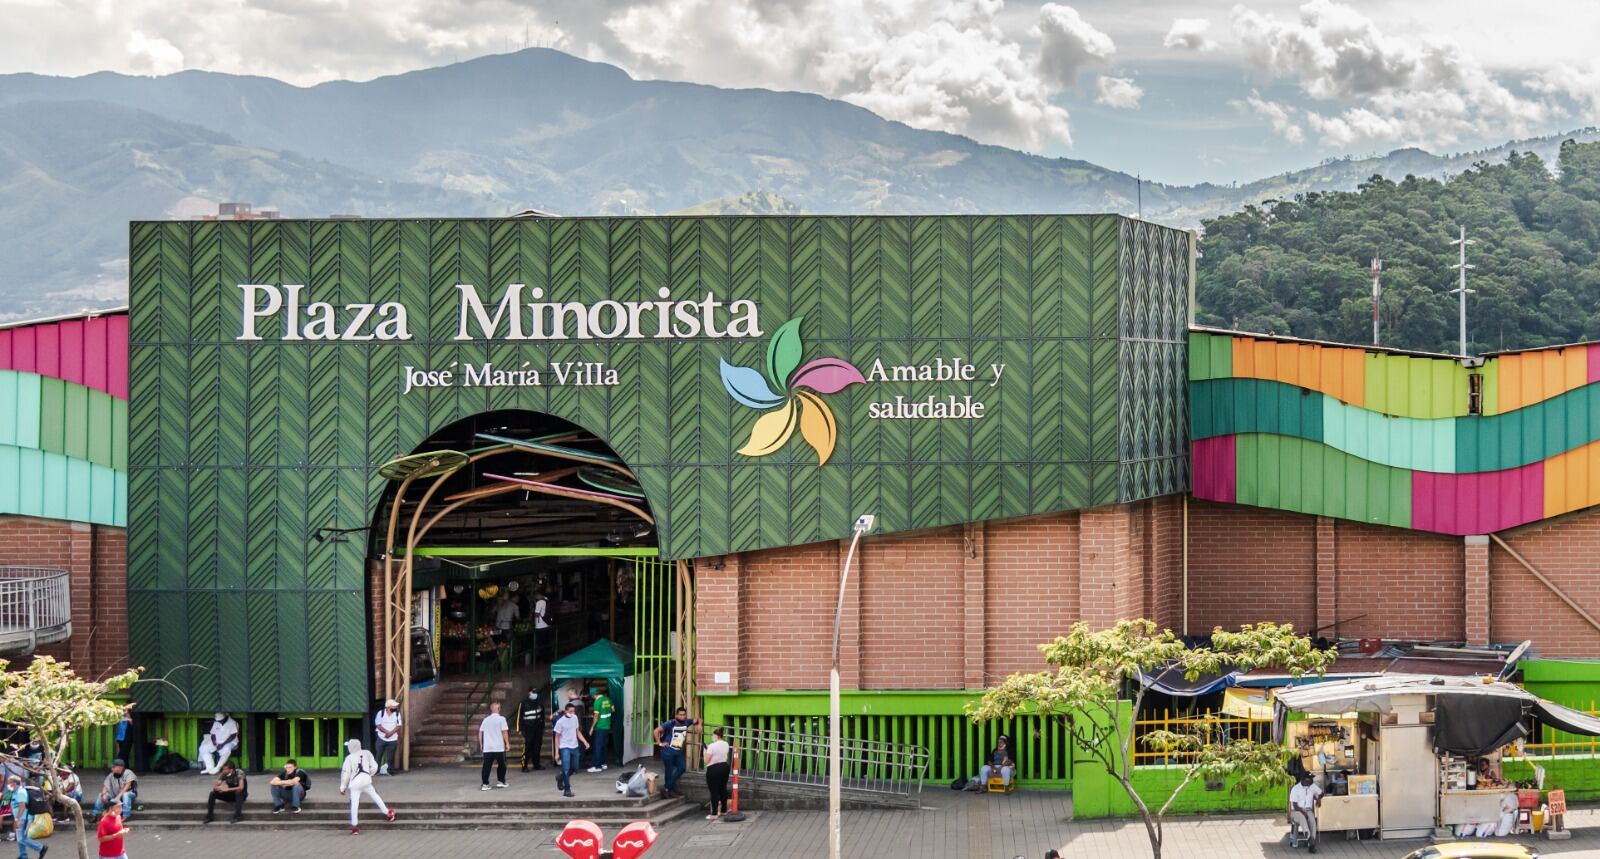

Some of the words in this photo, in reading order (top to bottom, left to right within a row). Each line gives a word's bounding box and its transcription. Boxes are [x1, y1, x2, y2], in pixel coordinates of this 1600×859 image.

[236, 284, 413, 340] Plaza
[453, 283, 764, 340] Minorista
[403, 361, 458, 395] José
[463, 361, 541, 387] María
[550, 361, 620, 386] Villa
[866, 357, 976, 382] Amable
[990, 363, 1006, 387] y
[868, 395, 985, 419] saludable
